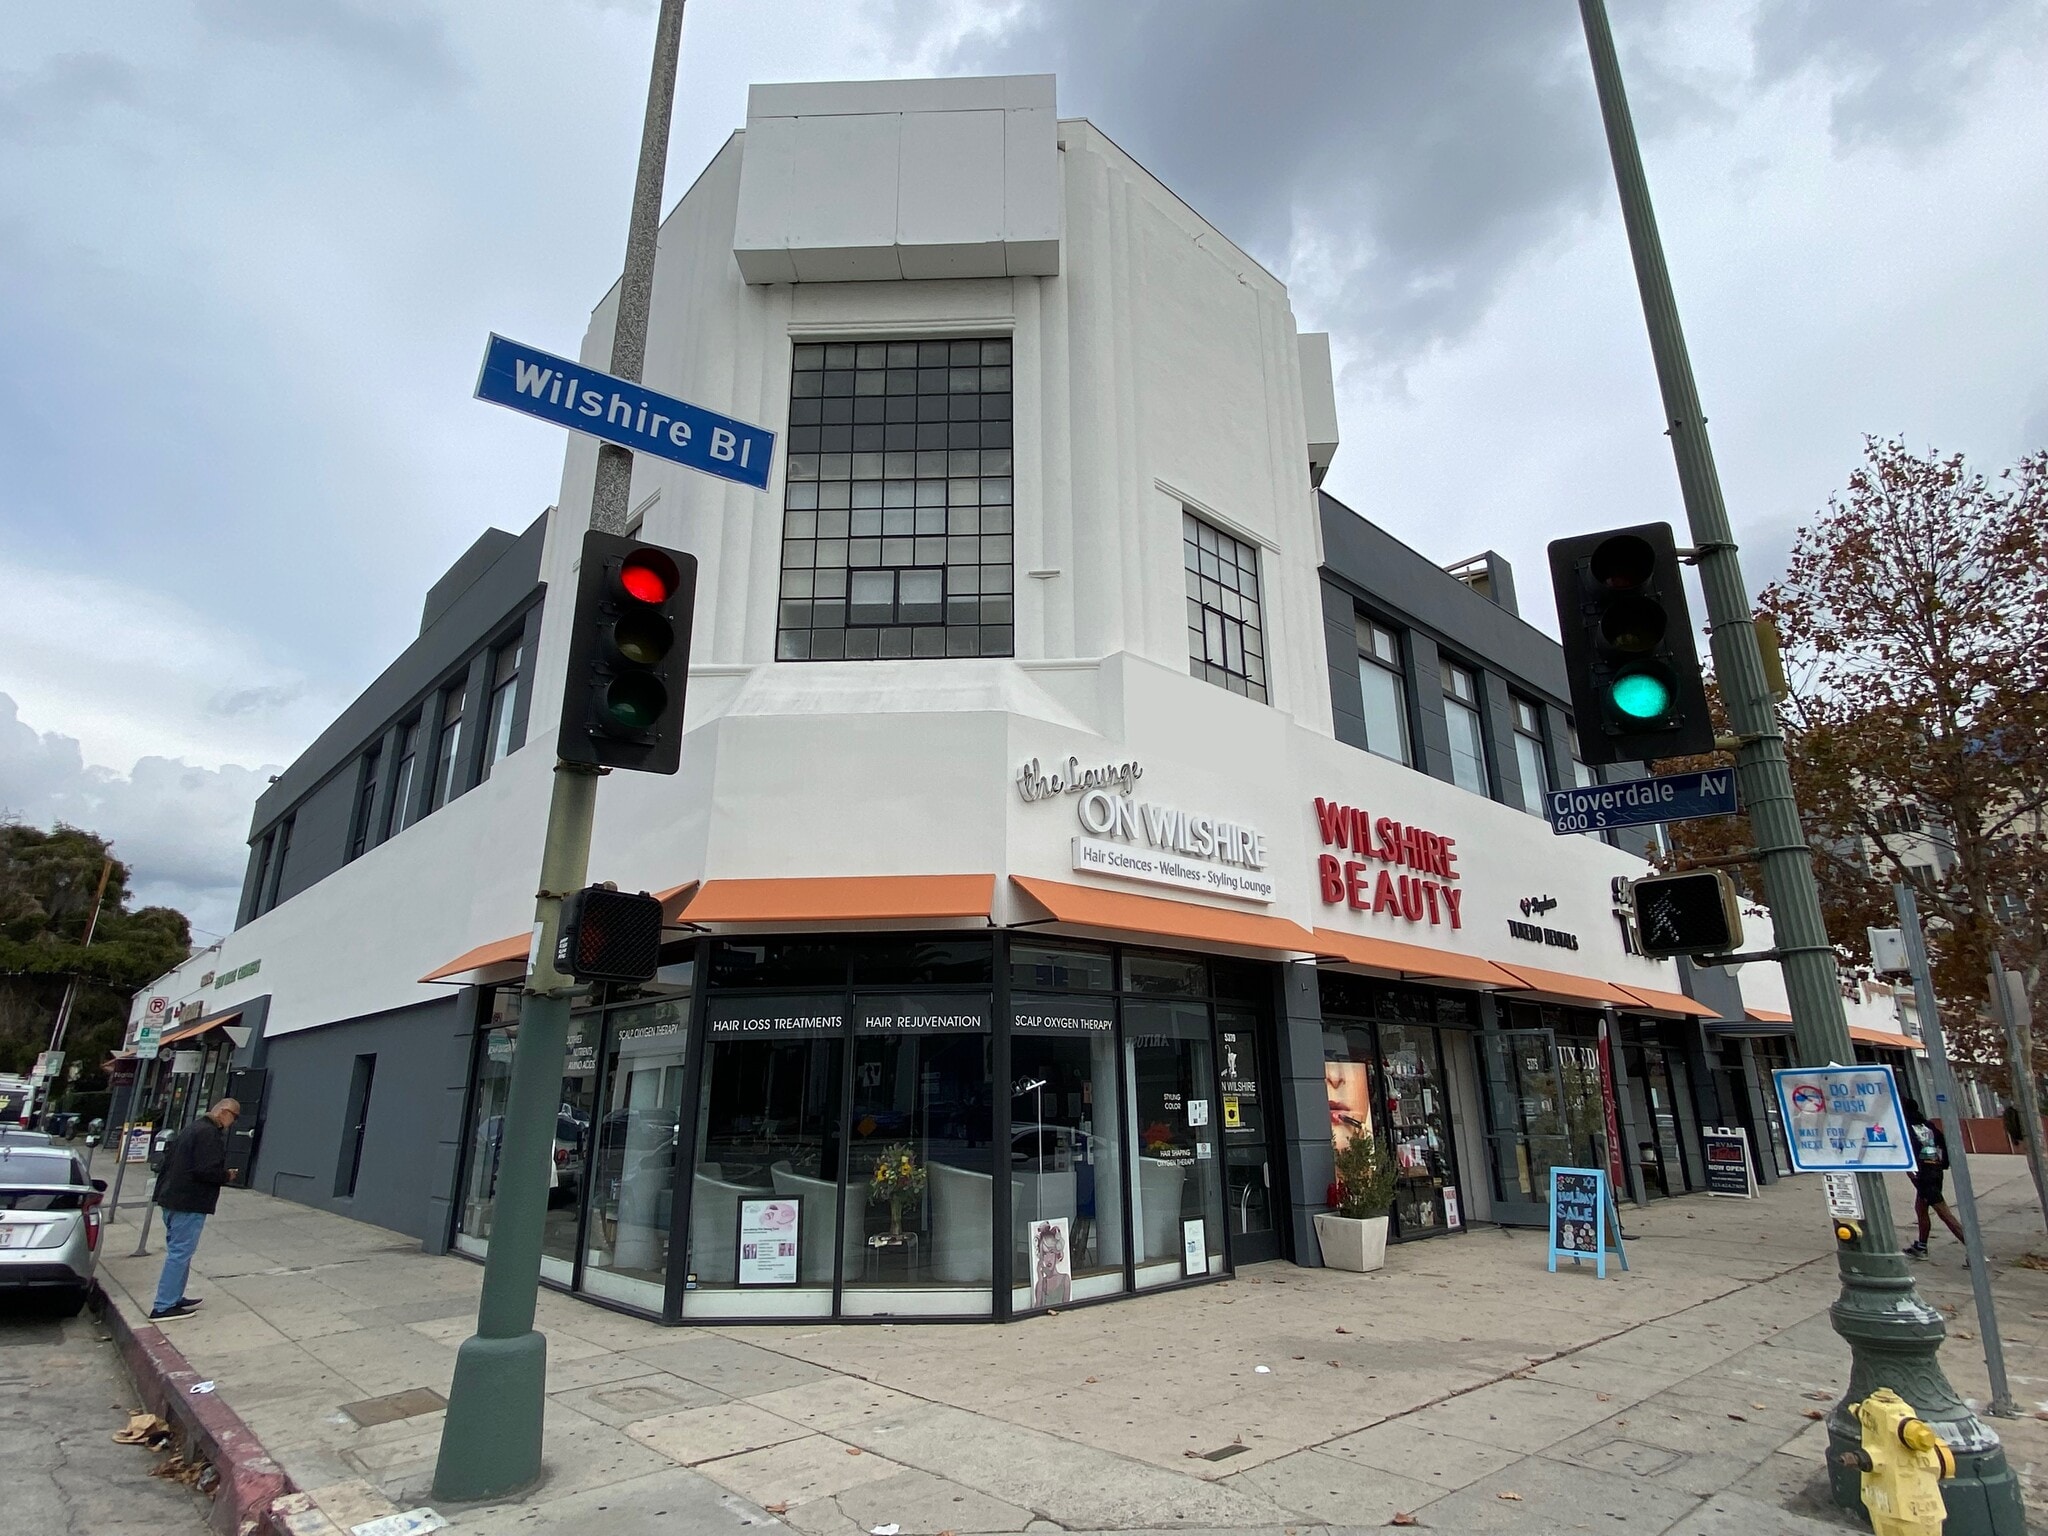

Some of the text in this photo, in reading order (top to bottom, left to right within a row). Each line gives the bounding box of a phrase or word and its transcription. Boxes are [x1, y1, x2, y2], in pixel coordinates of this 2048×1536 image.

[515, 358, 752, 468] Wilshire Bl
[1016, 756, 1143, 802] the Lounge
[1554, 774, 1727, 815] Cloverdale Av
[1078, 789, 1267, 869] ON WILSHIRE
[1557, 812, 1606, 831] 600 S
[1314, 797, 1460, 880] WILSHIRE
[1083, 846, 1107, 863] Hair
[1108, 851, 1152, 872] Sciences
[1160, 861, 1201, 881] Wellness
[1207, 871, 1238, 891] Styling
[1240, 877, 1272, 895] Lounge
[1319, 854, 1461, 929] BEAUTY
[713, 1016, 842, 1032] HAIR LOSS TREATMENTS
[865, 1015, 980, 1028] HAIR REJUVENATION
[1015, 1015, 1113, 1031] SCALP OXYGEN THERAPY
[1227, 1082, 1256, 1092] WILSHIRE
[1829, 1082, 1882, 1097] DO NOT
[1164, 1102, 1181, 1110] COLOR
[1833, 1100, 1866, 1112] PUSH
[1799, 1127, 1845, 1137] WAIT FOR
[1801, 1139, 1857, 1149] NEXT WALK
[1558, 1188, 1596, 1206] HOLIDAY
[1557, 1203, 1593, 1221] SALE
